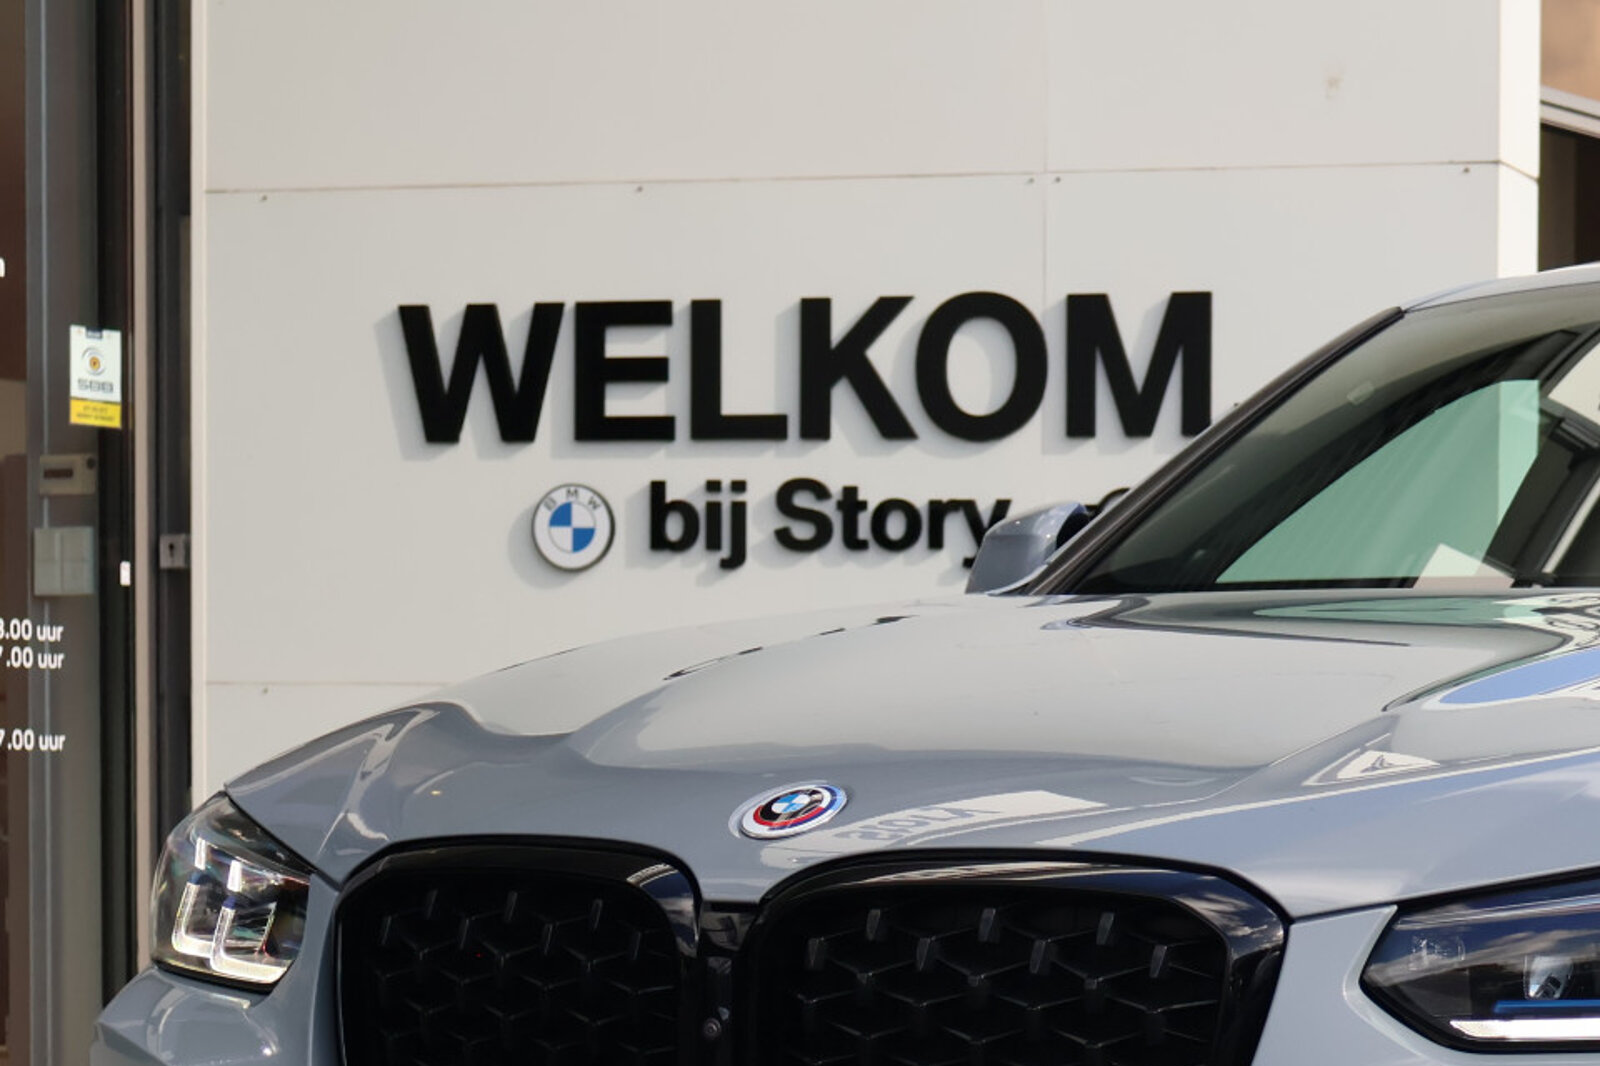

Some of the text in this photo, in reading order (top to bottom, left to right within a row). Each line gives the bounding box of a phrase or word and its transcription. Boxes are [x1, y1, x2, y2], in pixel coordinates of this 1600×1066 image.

[398, 290, 1213, 445] WELKOM
[649, 477, 1012, 571] bij Story
[36, 624, 64, 642] uur
[0, 645, 65, 670] .00 uur
[38, 733, 66, 752] uur
